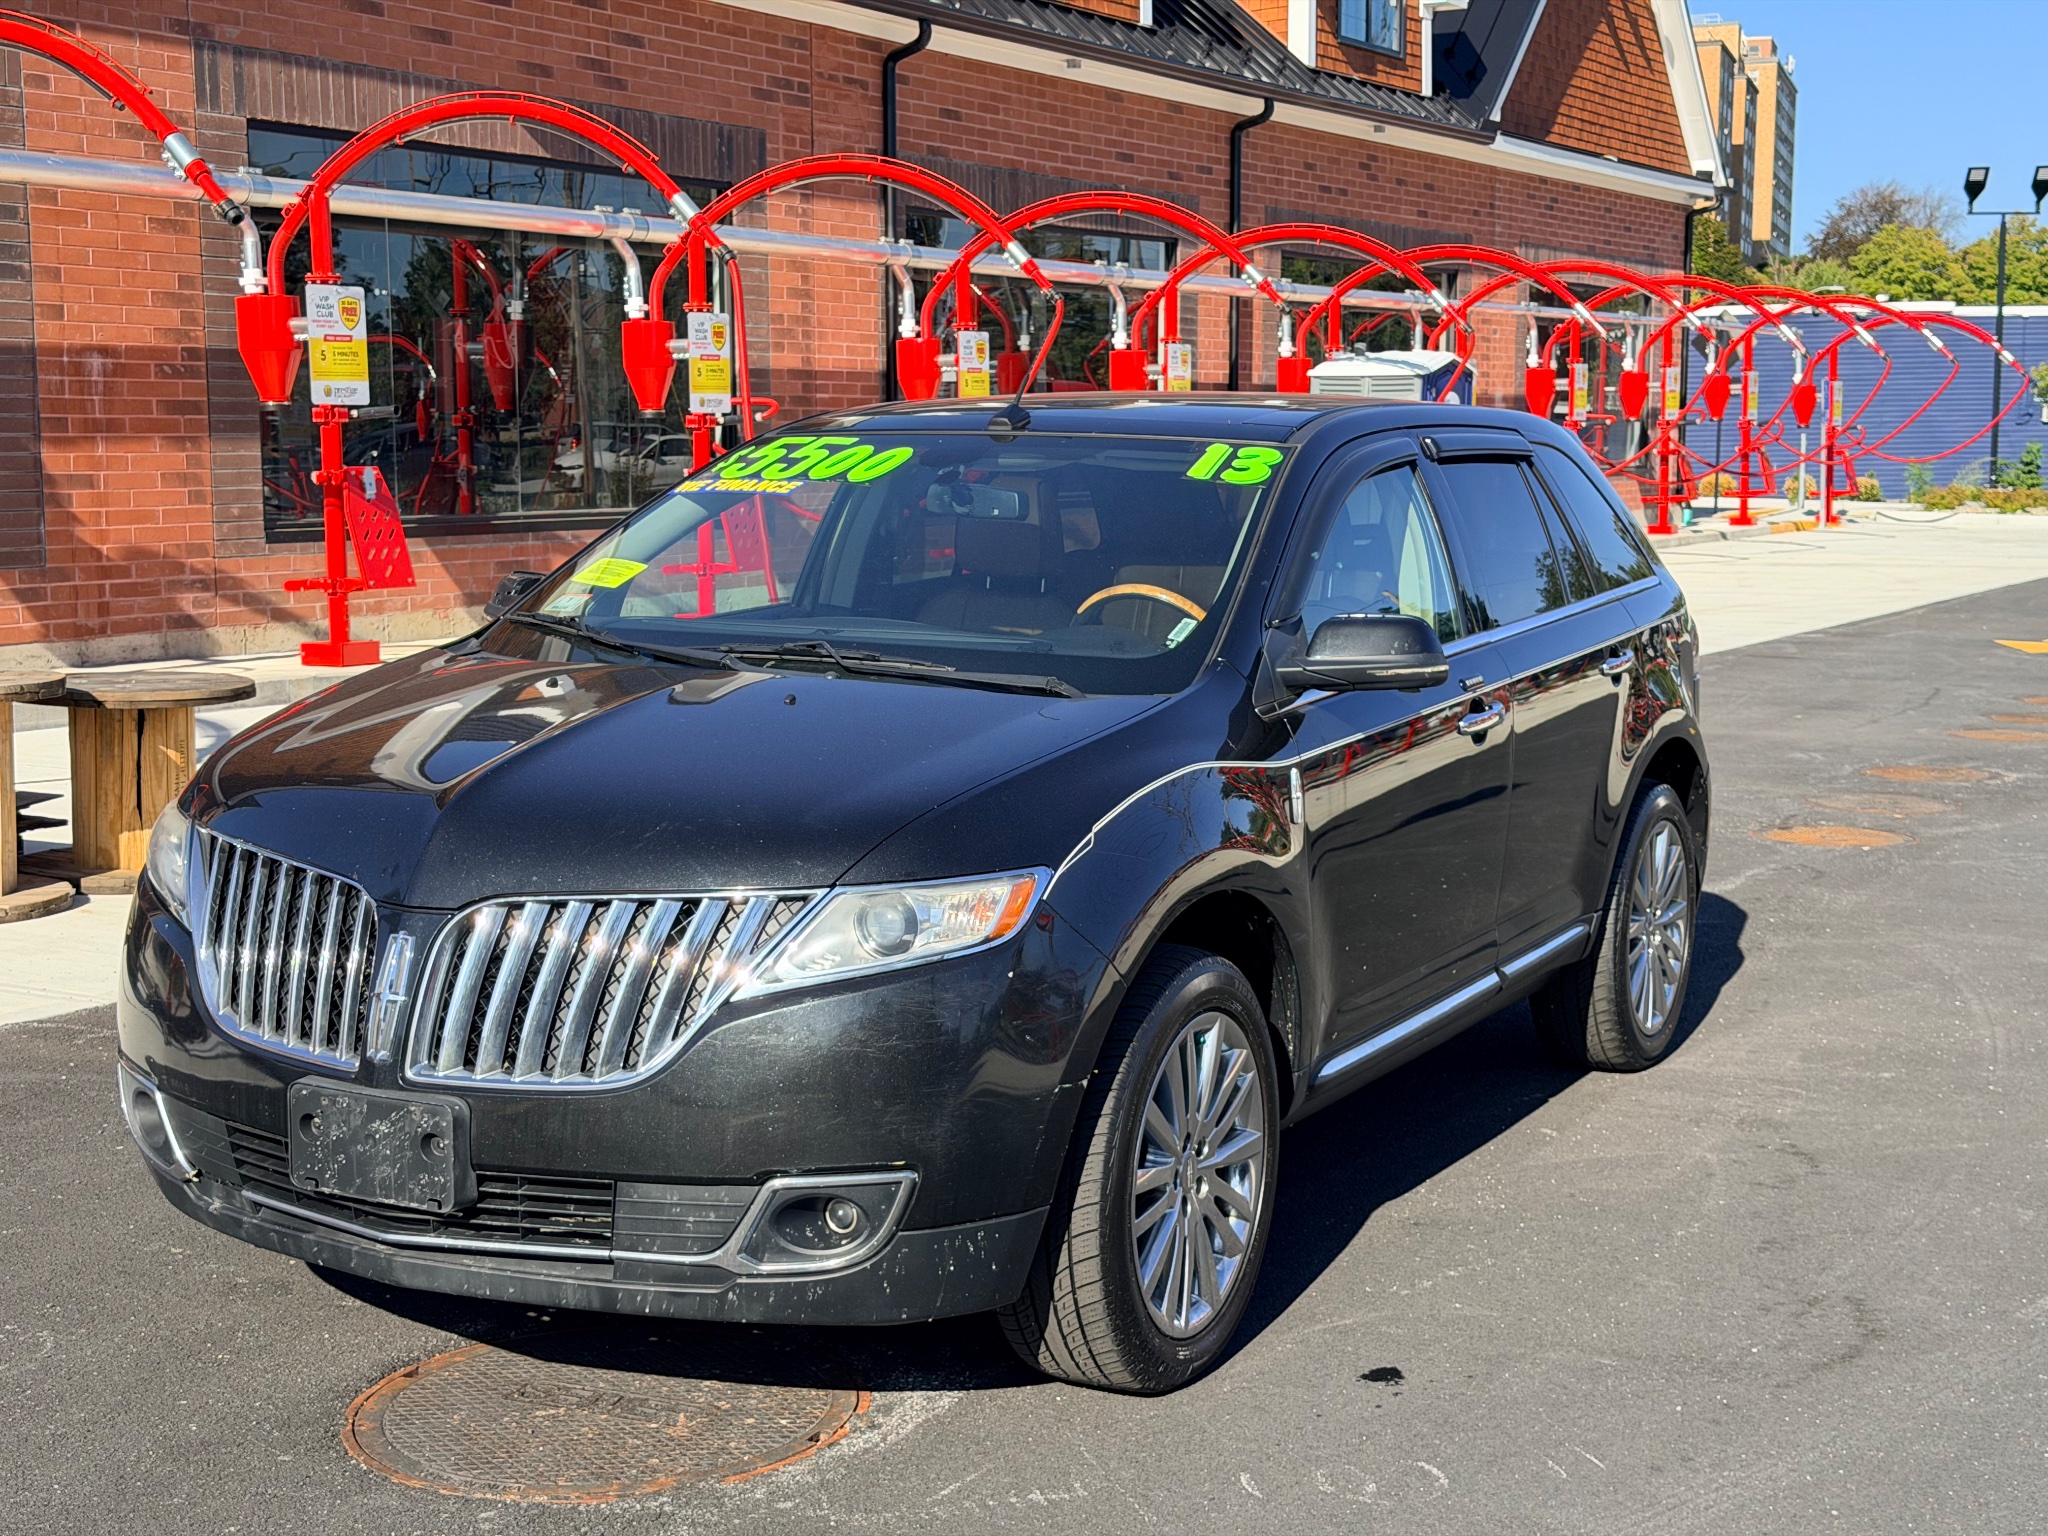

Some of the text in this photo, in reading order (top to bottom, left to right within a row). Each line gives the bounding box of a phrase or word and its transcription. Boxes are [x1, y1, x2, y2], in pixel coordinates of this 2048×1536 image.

[315, 303, 335, 311] WASH
[342, 307, 358, 316] FREE
[321, 350, 327, 361] 5
[697, 367, 702, 377] 5
[1186, 443, 1284, 485] 13
[674, 479, 804, 494] WE FINANCE
